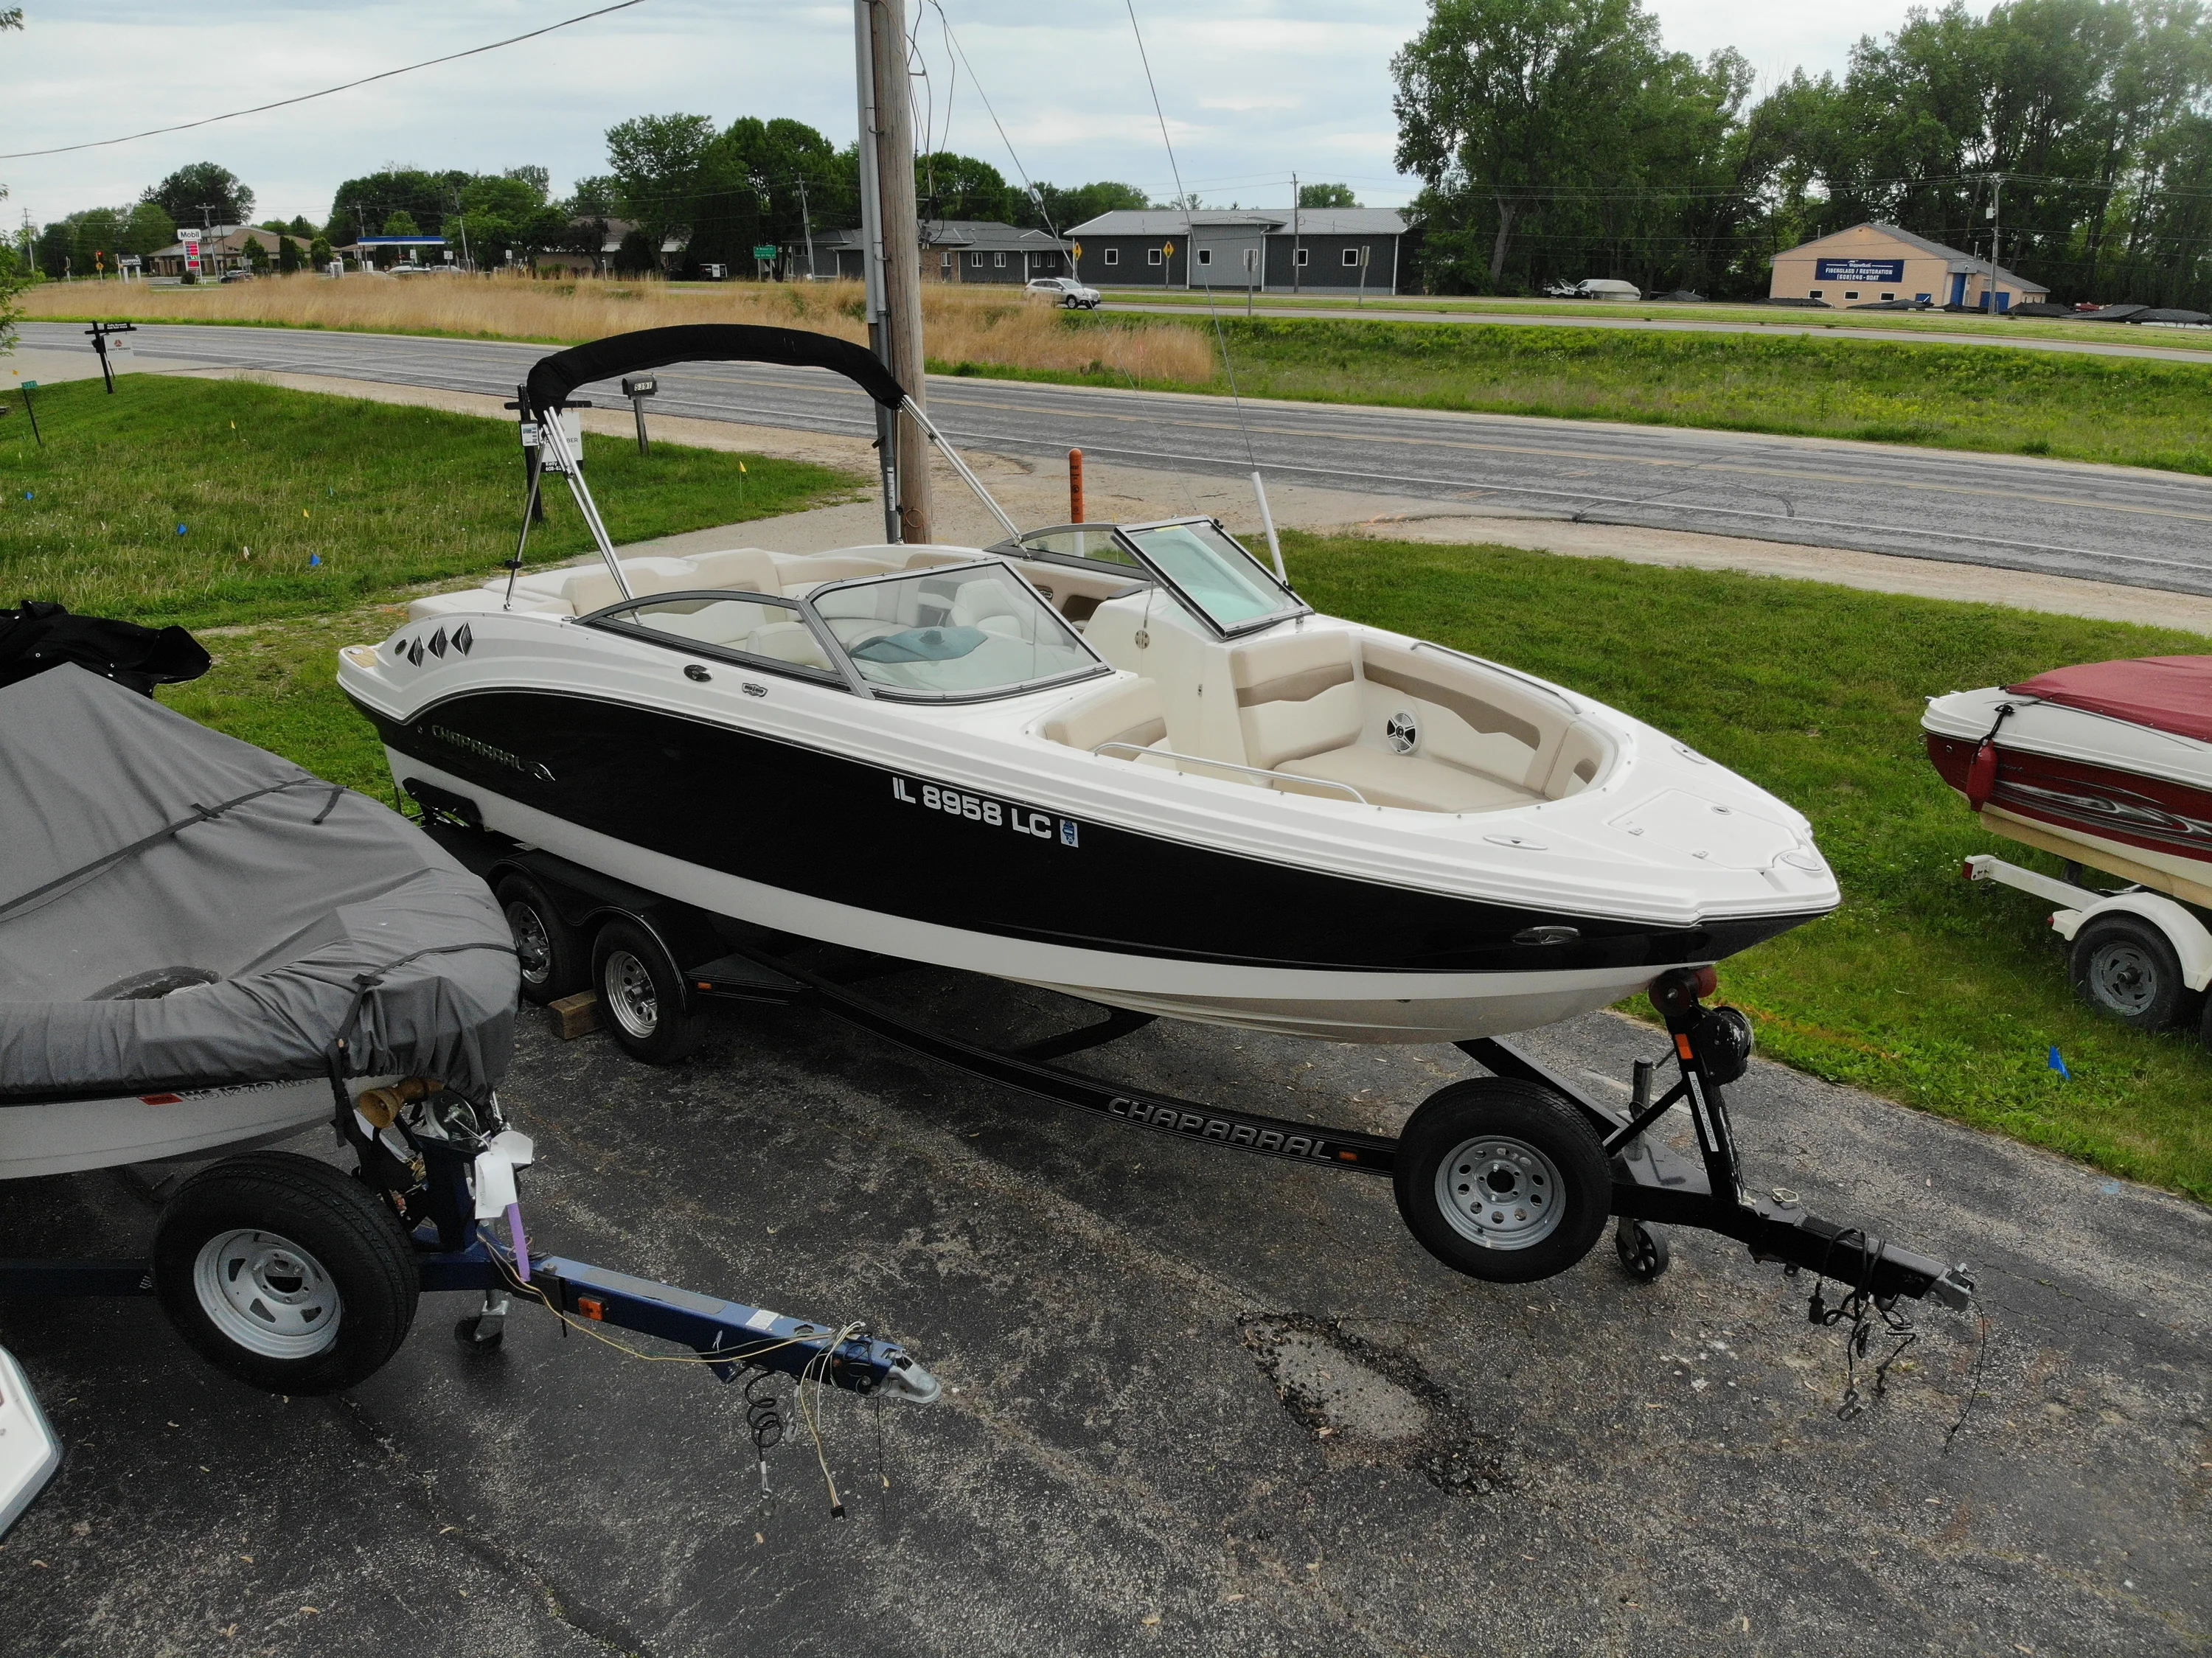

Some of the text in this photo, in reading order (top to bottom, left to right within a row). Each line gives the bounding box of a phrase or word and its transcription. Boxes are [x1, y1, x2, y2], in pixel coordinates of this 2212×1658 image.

[635, 383, 652, 391] 5391
[432, 724, 526, 772] CHAPARRAL
[892, 776, 917, 804] IL
[923, 785, 1003, 826] 8958
[1011, 808, 1052, 839] LC
[219, 1082, 274, 1097] 1279
[1691, 1079, 1707, 1115] ROBINSON
[1107, 1098, 1332, 1160] CHAPARRAL
